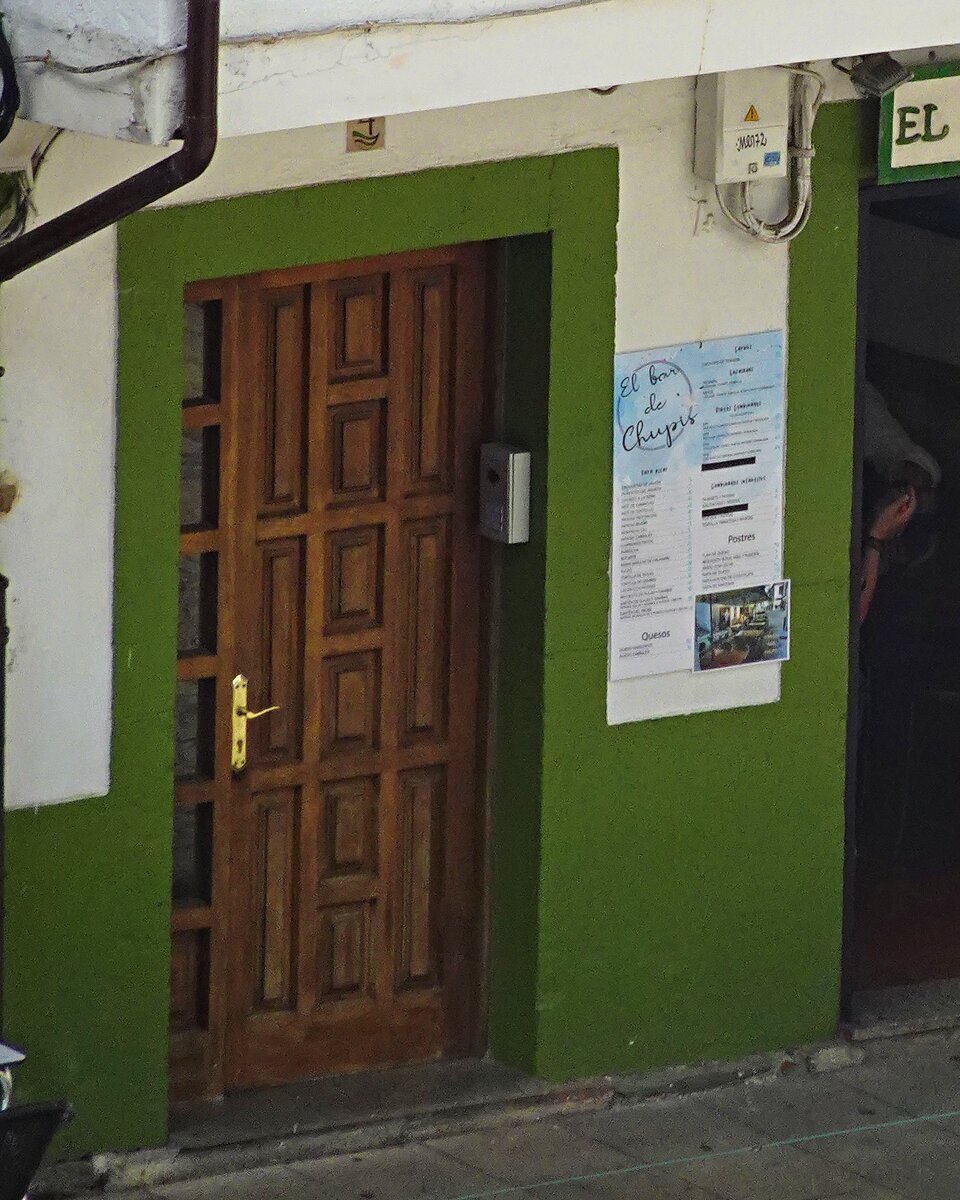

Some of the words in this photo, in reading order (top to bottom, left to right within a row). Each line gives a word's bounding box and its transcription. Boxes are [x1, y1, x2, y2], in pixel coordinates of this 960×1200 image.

[895, 103, 950, 145] EL
[620, 373, 640, 398] El
[649, 364, 678, 386] bar
[644, 393, 667, 414] de
[622, 413, 698, 452] Chupis
[728, 534, 756, 544] Postres
[641, 630, 671, 641] Quesos
